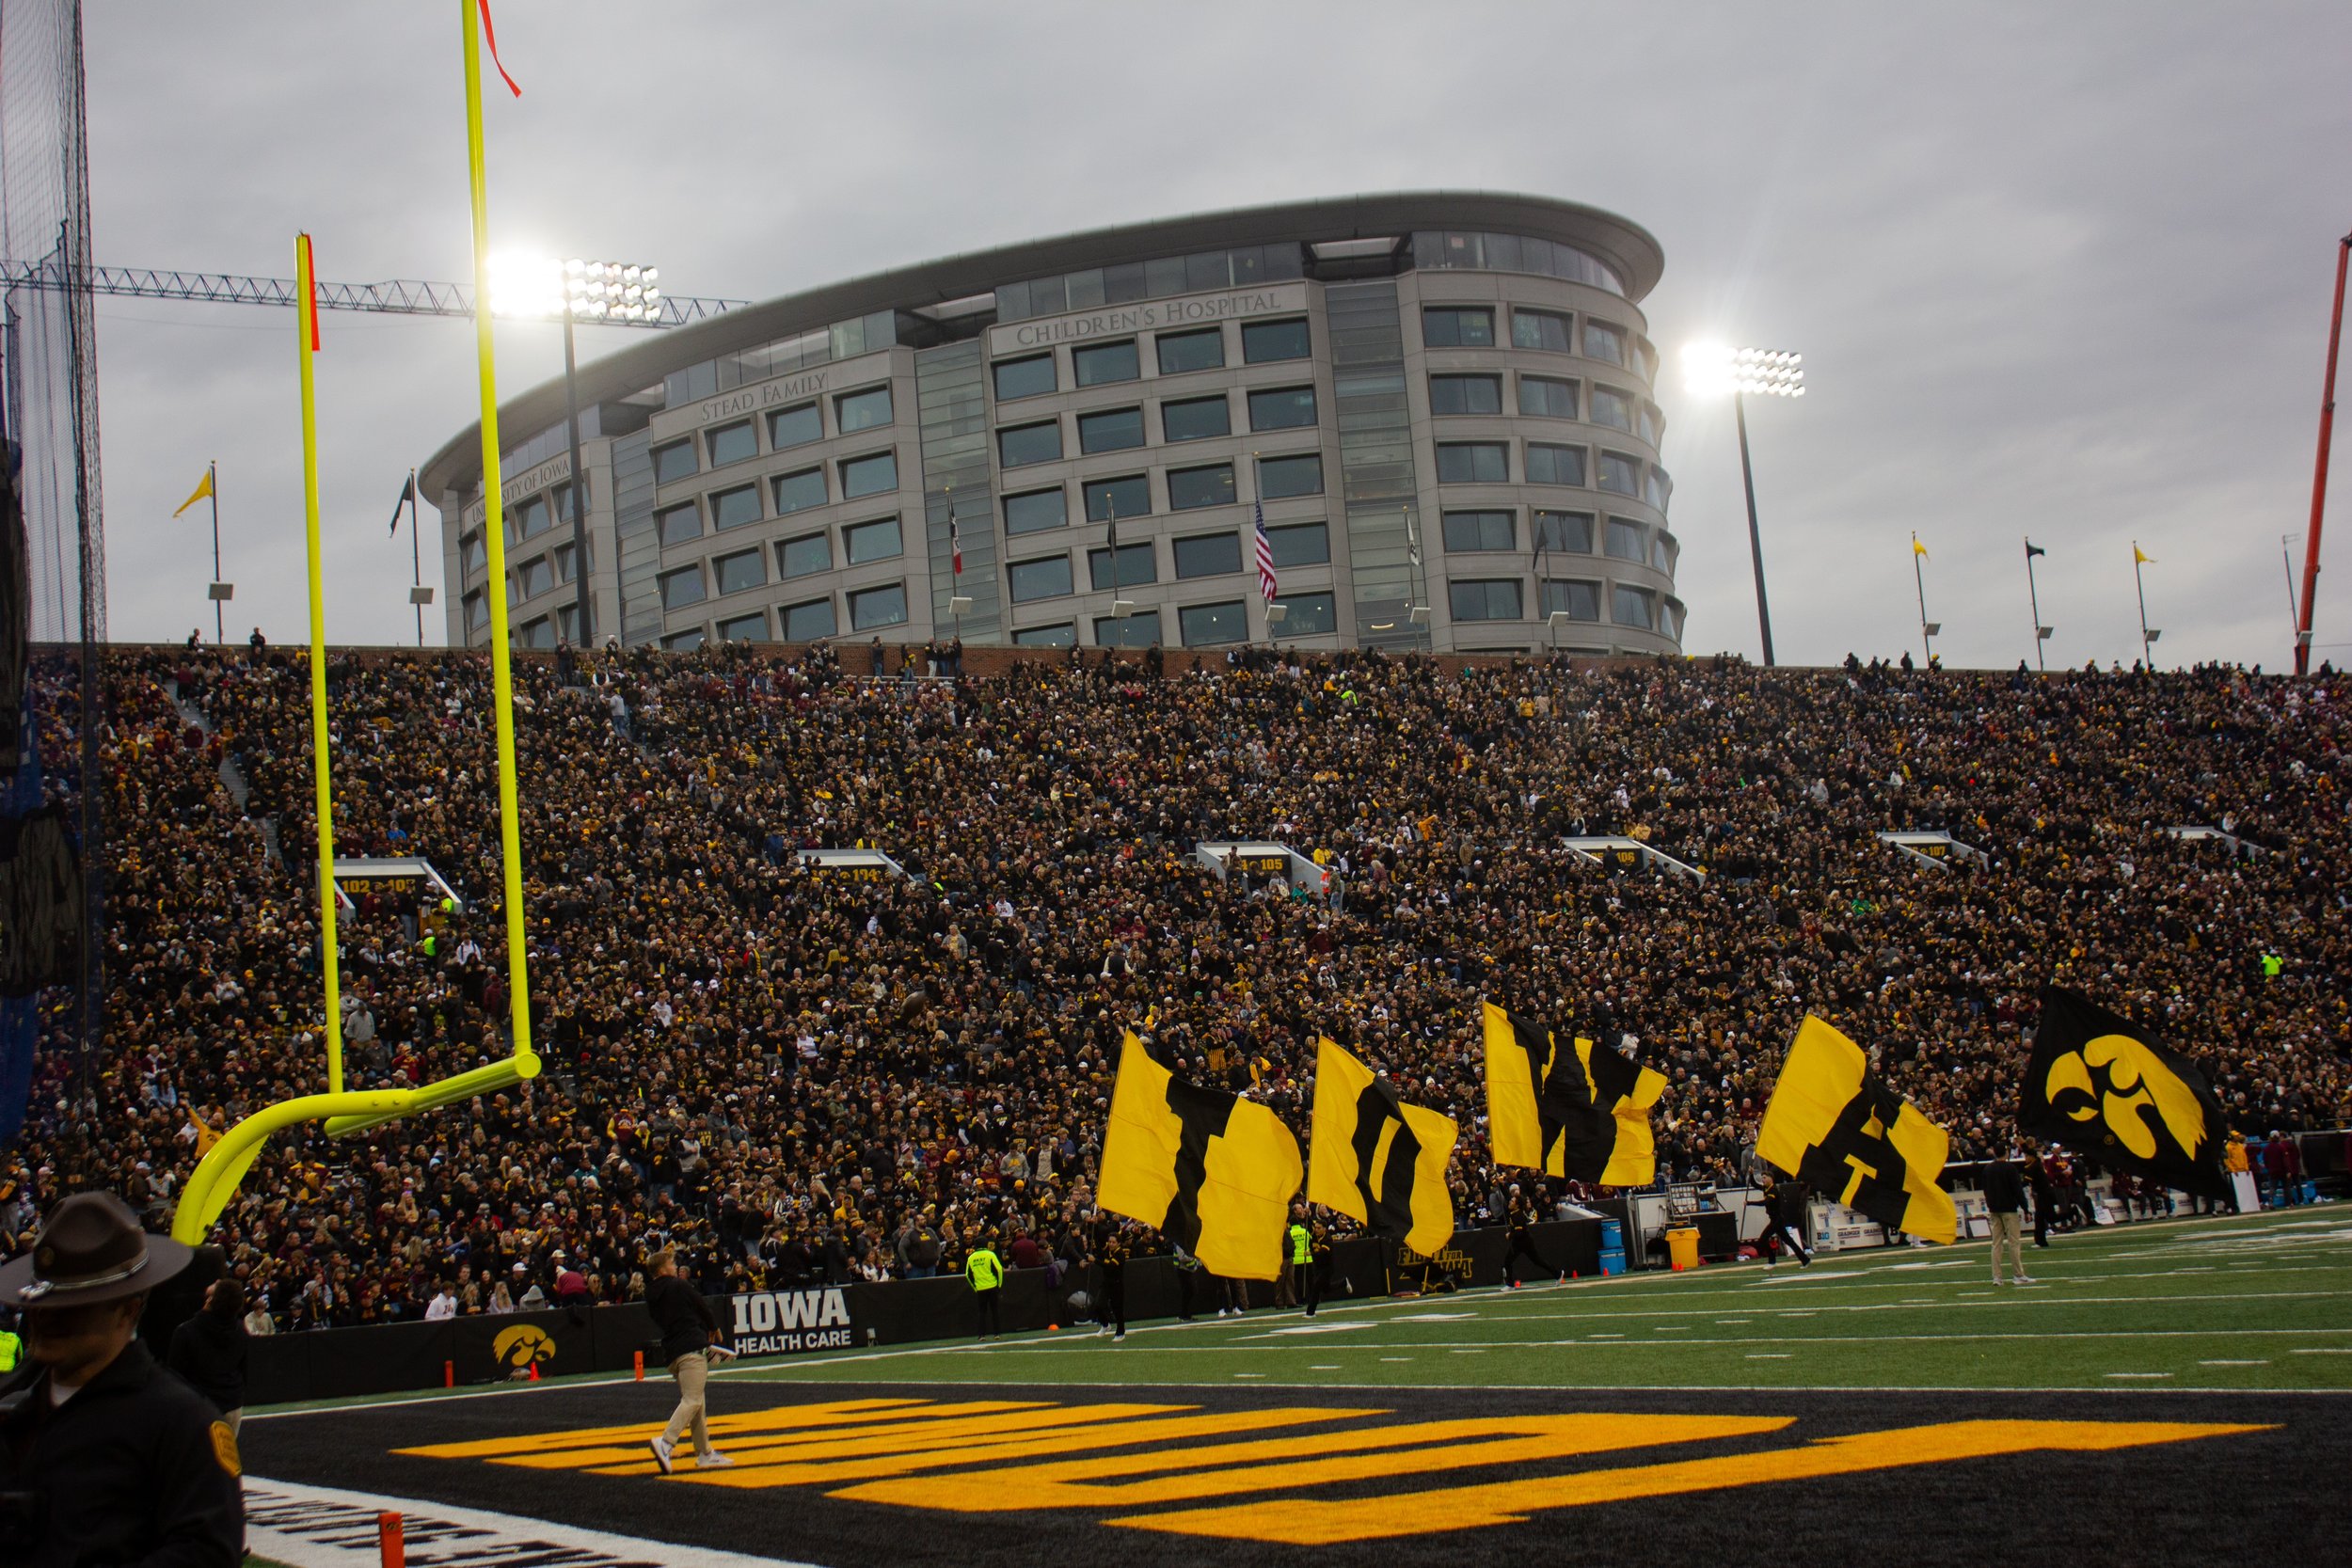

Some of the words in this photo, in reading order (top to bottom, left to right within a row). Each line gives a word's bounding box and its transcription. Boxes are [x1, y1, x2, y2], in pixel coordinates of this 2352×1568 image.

[1017, 307, 1155, 345] CHILDREN'S
[1166, 292, 1280, 324] HOSPITAL
[702, 393, 754, 421] STEAD
[763, 372, 826, 404] FAMILY
[524, 475, 537, 491] OF
[540, 459, 570, 484] IOWA
[1261, 858, 1284, 871] 105
[1928, 846, 1947, 857] 107
[342, 879, 371, 895] 102
[732, 1288, 850, 1334] IOWA
[735, 1333, 802, 1354] HEALTH
[805, 1329, 851, 1349] CARE
